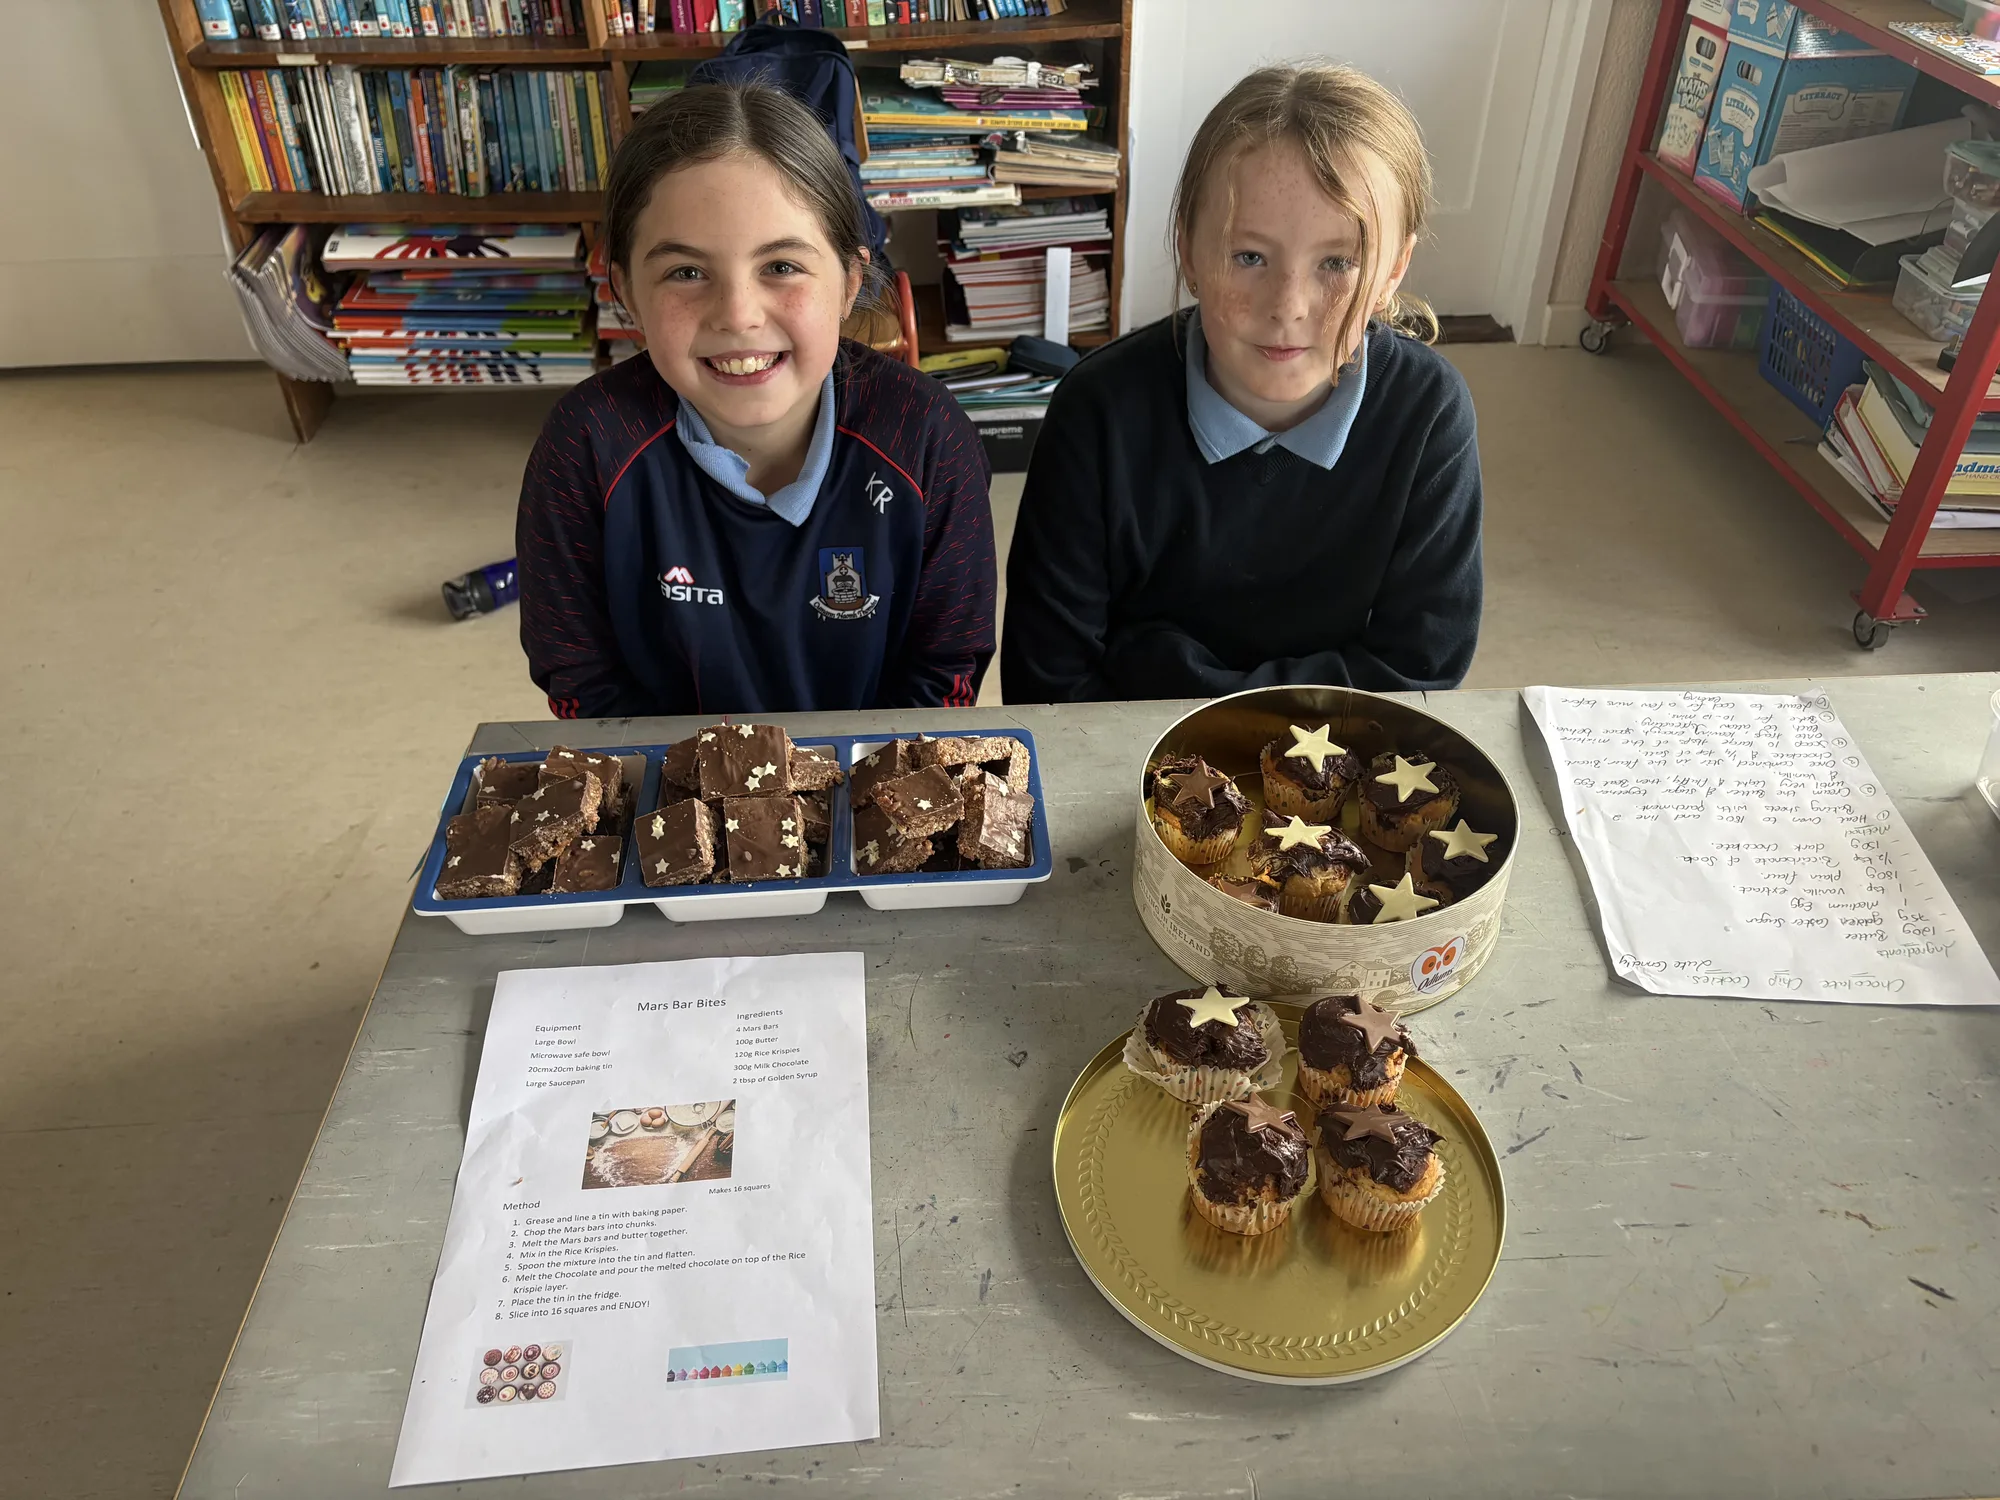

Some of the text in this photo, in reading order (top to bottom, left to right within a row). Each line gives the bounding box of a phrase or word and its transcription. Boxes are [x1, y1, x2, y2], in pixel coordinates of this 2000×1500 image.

[1677, 77, 1709, 100] MATHS
[1679, 93, 1700, 112] BOX
[1799, 91, 1843, 101] LITERACY
[1725, 97, 1756, 120] LITERACY
[978, 426, 1024, 436] supreme
[1793, 843, 1825, 852] dark
[1810, 870, 1842, 883] plain
[1897, 909, 1930, 922] 75g
[1169, 921, 1211, 957] IRELAND
[1843, 923, 1936, 941] 120g Butter
[1876, 940, 1956, 957] Ingredients
[1768, 974, 1803, 991] Chip
[1819, 978, 1905, 992] Chocolate
[637, 998, 726, 1011] Mars Bar Bites
[736, 1009, 783, 1020] Ingredients
[535, 1024, 581, 1032] Equipment
[771, 1047, 800, 1055] Krispies
[771, 1059, 809, 1068] Chocolate
[525, 1080, 548, 1088] Large
[502, 1200, 541, 1210] Method
[525, 1217, 555, 1225] Grease
[556, 1215, 573, 1223] and
[611, 1210, 631, 1218] with
[632, 1209, 660, 1217] baking
[661, 1207, 688, 1216] paper.
[523, 1228, 546, 1236] Chop
[625, 1219, 657, 1228] chunks.
[522, 1239, 542, 1247] Melt
[544, 1238, 558, 1246] the
[583, 1235, 602, 1243] bars
[603, 1232, 619, 1241] and
[649, 1228, 689, 1238] together.
[584, 1244, 619, 1254] Krispies.
[504, 1263, 512, 1271] 5.
[517, 1262, 545, 1271] Spoon
[546, 1260, 562, 1268] the
[563, 1258, 597, 1266] mixture
[617, 1254, 632, 1262] the
[647, 1252, 664, 1260] and
[665, 1250, 695, 1258] flatten.
[501, 1275, 510, 1283] 6.
[515, 1273, 536, 1281] Melt
[538, 1272, 553, 1280] the
[554, 1269, 598, 1278] Chocolate
[599, 1266, 616, 1275] and
[617, 1266, 638, 1275] pour
[640, 1264, 655, 1272] the
[656, 1261, 687, 1271] melted
[688, 1259, 730, 1267] chocolate
[761, 1253, 771, 1262] of
[772, 1253, 787, 1261] the
[513, 1283, 568, 1294] Krispie layer.
[498, 1299, 506, 1307] 7.
[511, 1298, 535, 1306] Place
[536, 1296, 551, 1304] the
[553, 1294, 565, 1302] tin
[594, 1290, 622, 1299] fridge.
[494, 1312, 503, 1320] 8.
[508, 1310, 529, 1319] Slice
[551, 1306, 562, 1315] 16
[564, 1305, 598, 1315] squares
[600, 1302, 617, 1311] and
[618, 1300, 650, 1309] ENJOY!
